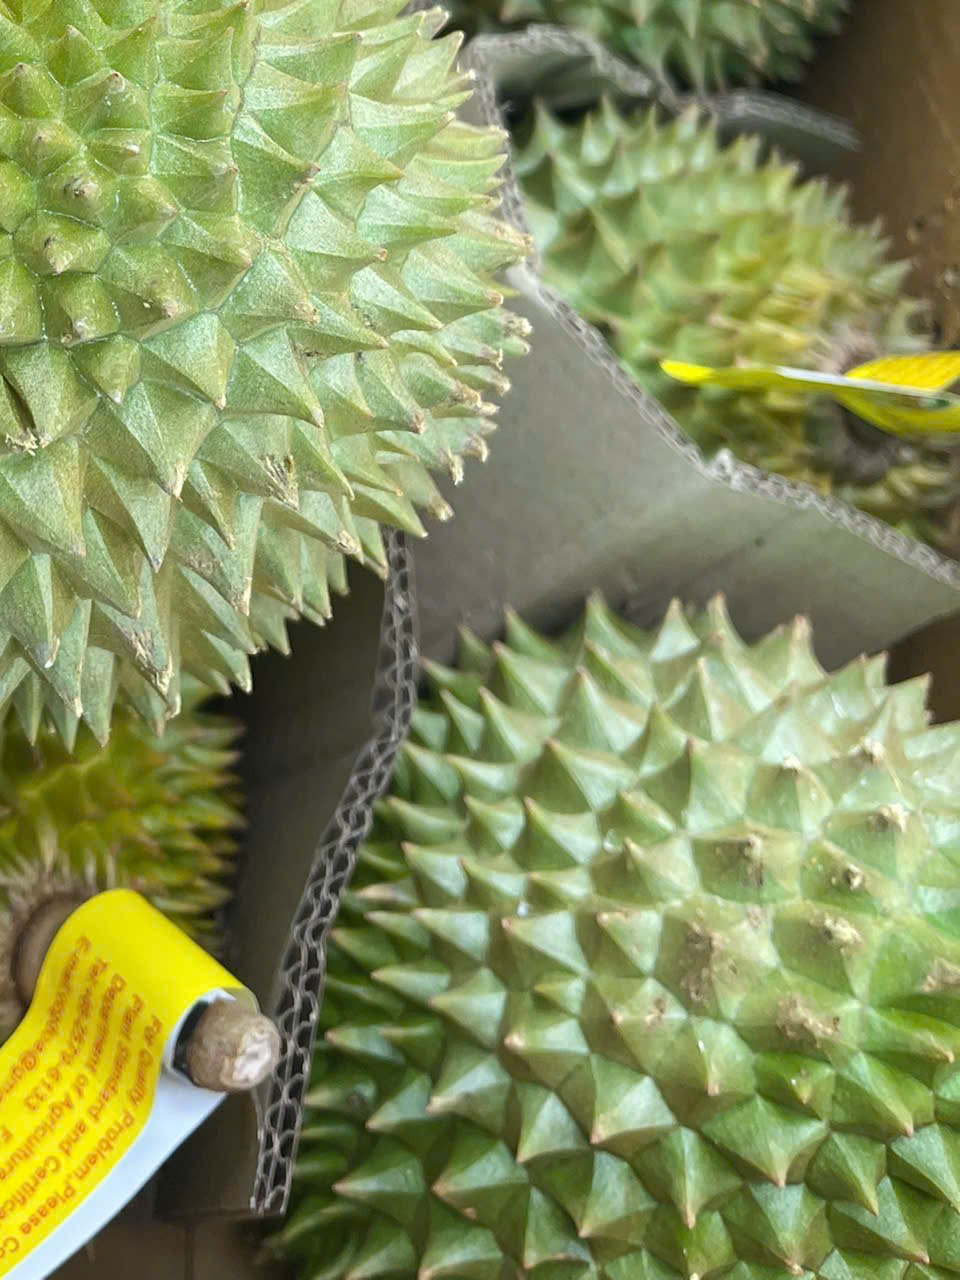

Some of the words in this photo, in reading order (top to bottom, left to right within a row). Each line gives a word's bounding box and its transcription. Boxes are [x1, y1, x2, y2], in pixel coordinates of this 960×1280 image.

[71, 1072, 88, 1098] of
[88, 1041, 130, 1123] Standard
[57, 1119, 89, 1158] and
